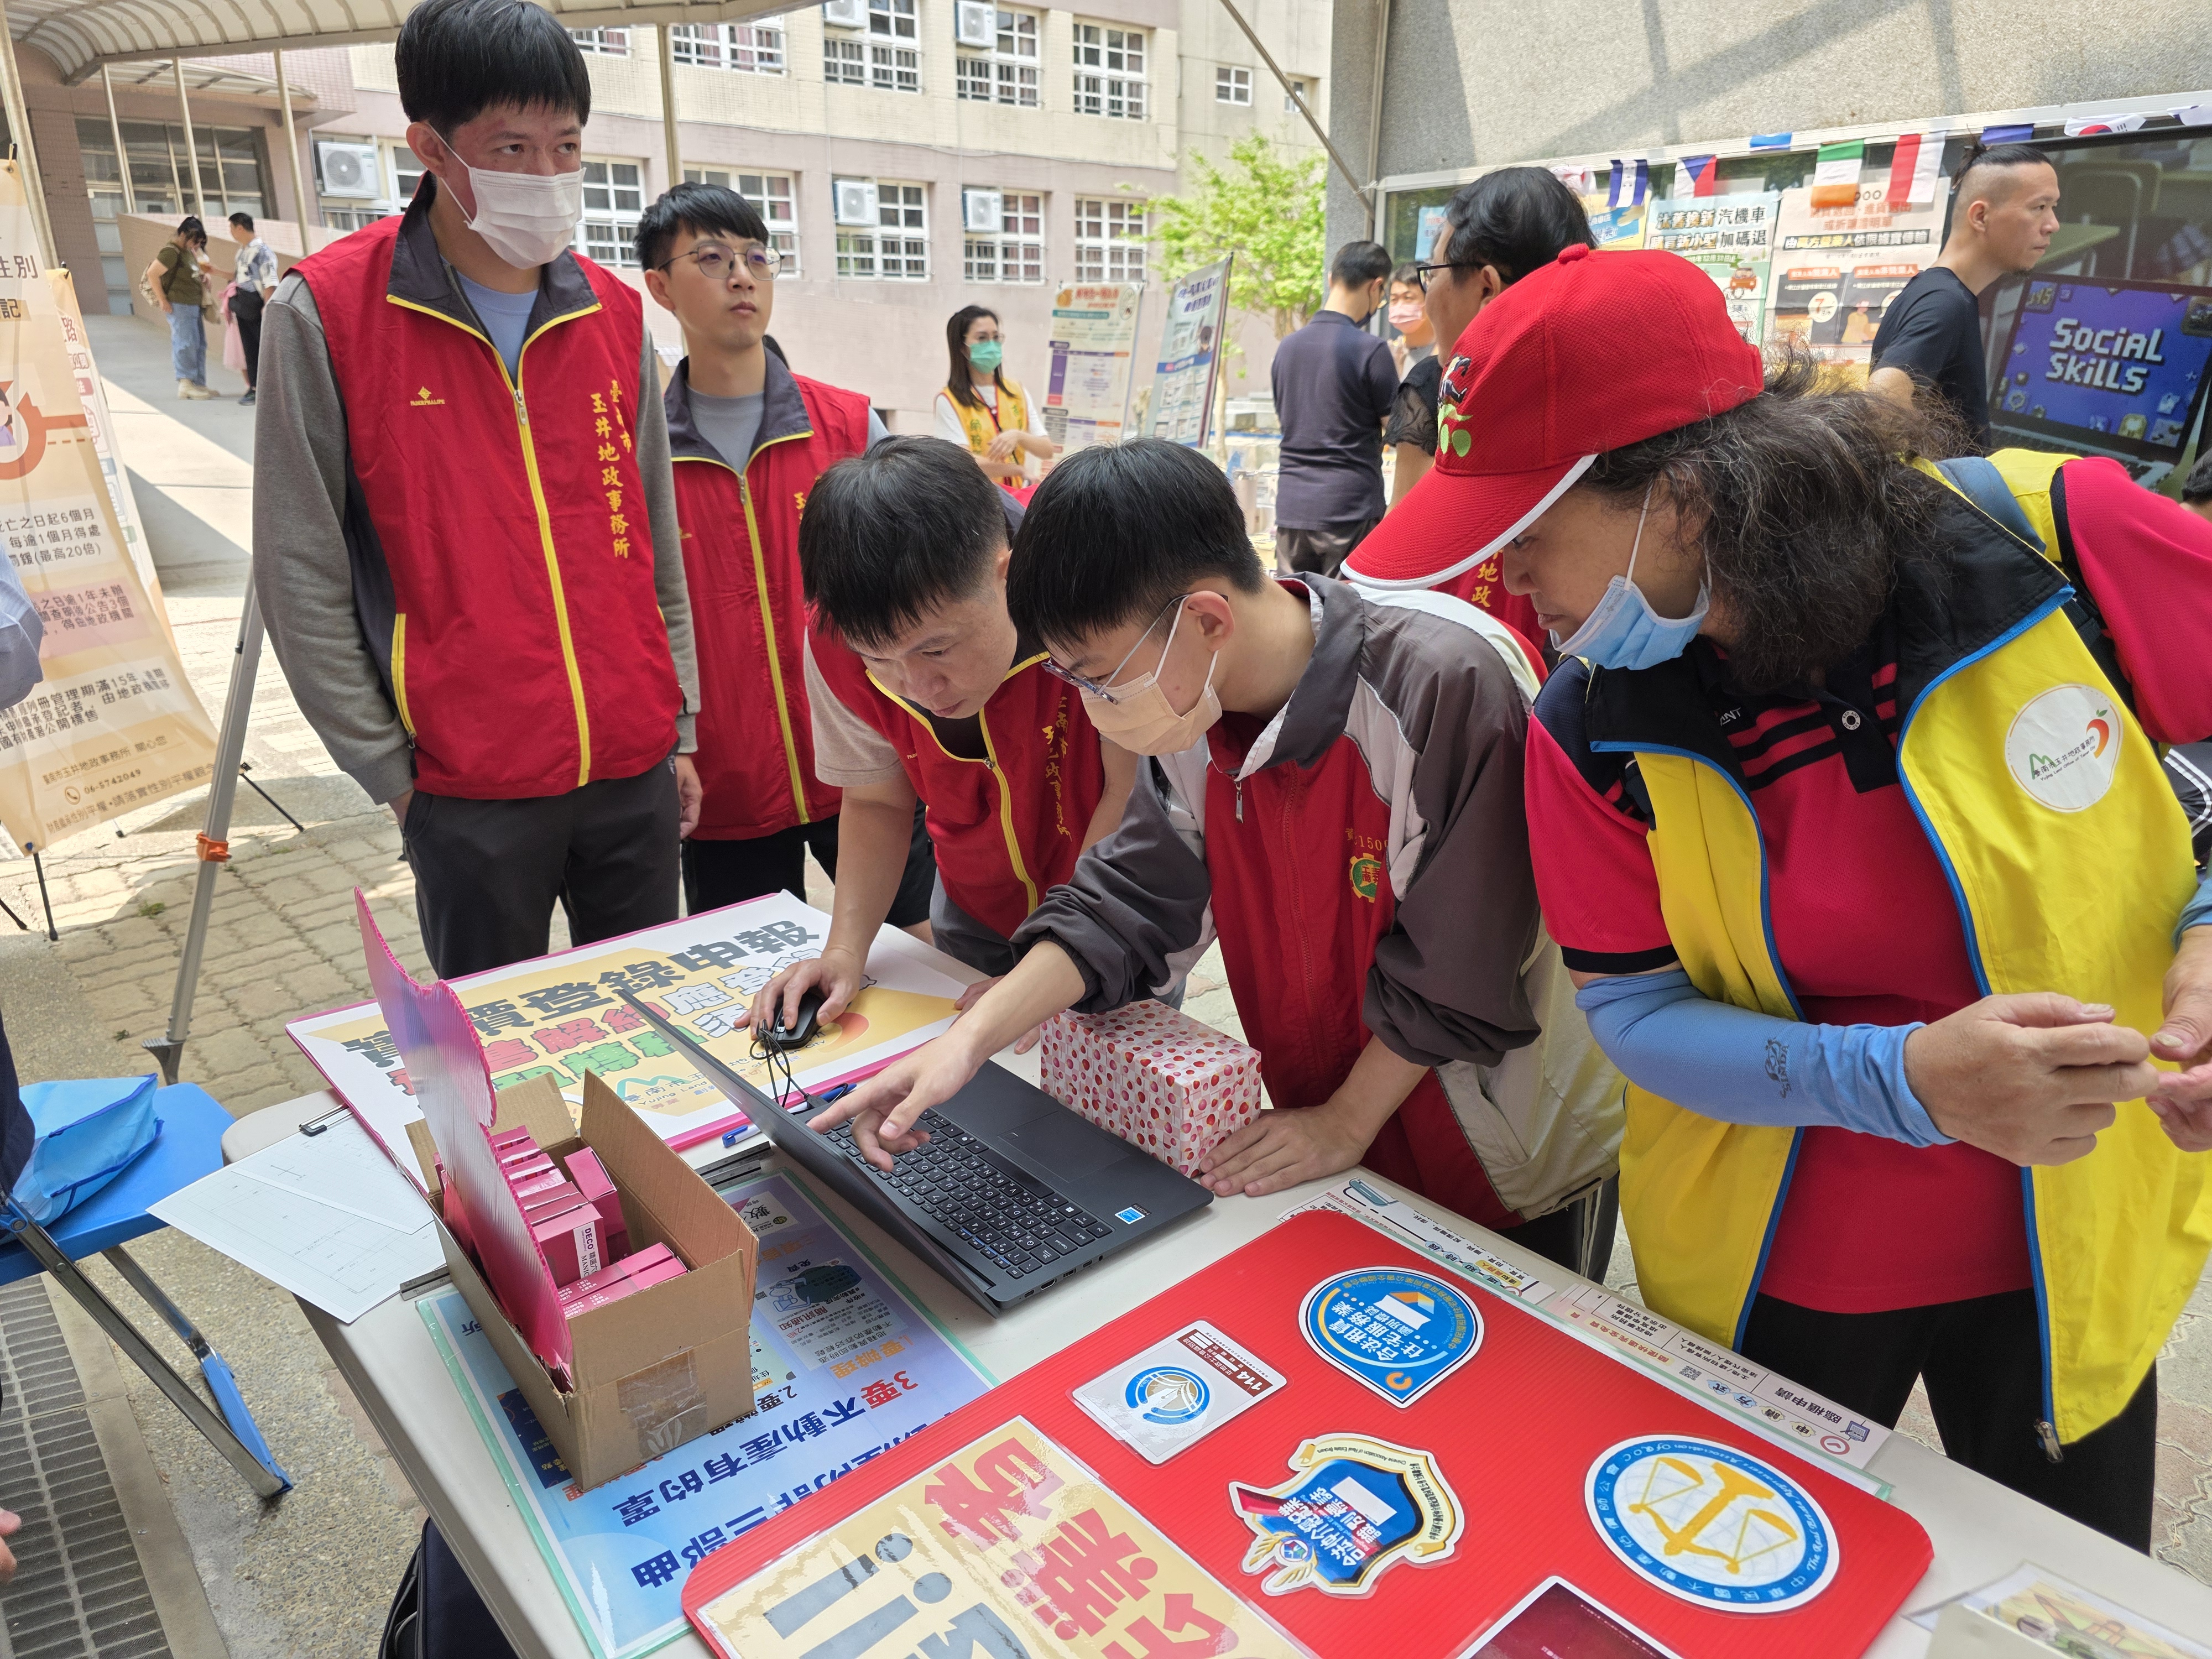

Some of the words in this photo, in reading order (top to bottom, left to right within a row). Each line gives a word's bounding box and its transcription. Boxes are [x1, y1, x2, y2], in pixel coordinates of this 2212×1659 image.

[1718, 206, 1766, 225] 汽機車
[1720, 229, 1767, 247] 加碼退
[590, 392, 630, 559] 玉井地政事務所
[1720, 707, 1741, 726] ANT
[42, 745, 132, 785] 臺南市玉井地政事務所
[638, 1092, 676, 1105] Yujing
[680, 1081, 708, 1093] Land
[805, 1040, 826, 1049] City
[740, 1202, 771, 1225] 數
[585, 1227, 594, 1250] DECO
[778, 1304, 828, 1332] 簡訊通知
[1331, 1297, 1423, 1361] 住宅服務業
[1610, 1313, 1653, 1337] 地政事務所
[1328, 1314, 1397, 1365] 合法租賃
[1237, 1370, 1262, 1390] 114
[1773, 1385, 1843, 1425] 臨櫃申請
[1277, 1496, 1366, 1569] 合法仲介經紀業
[1308, 1486, 1381, 1545] 識別標誌
